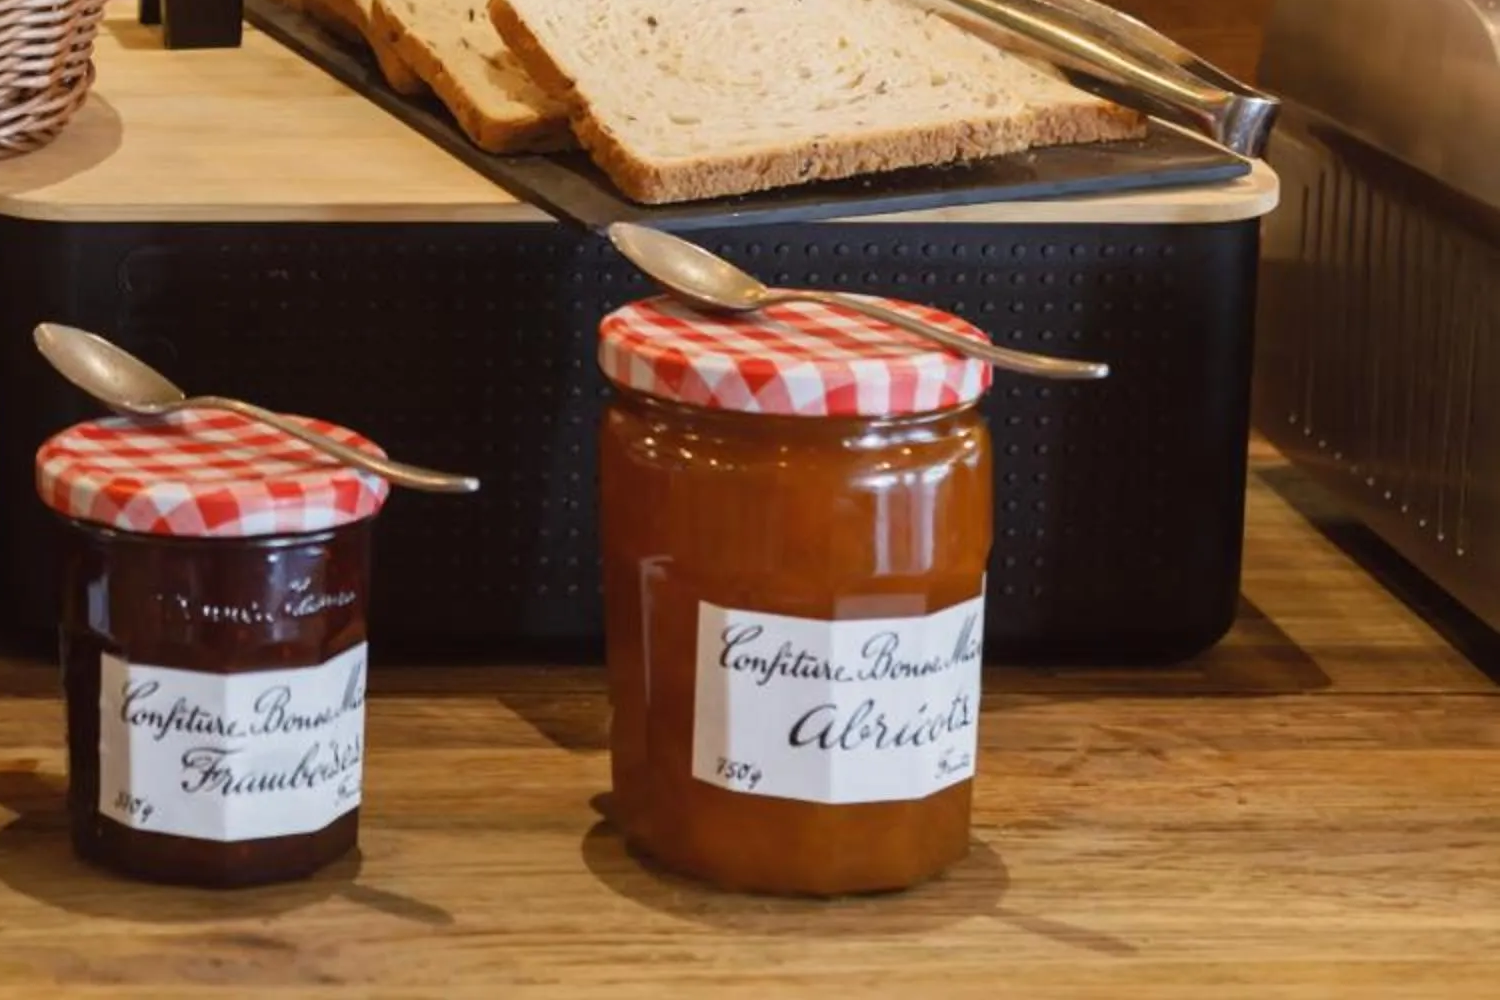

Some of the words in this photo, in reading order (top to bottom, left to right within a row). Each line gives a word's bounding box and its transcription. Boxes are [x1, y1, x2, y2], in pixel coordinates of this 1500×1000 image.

[718, 624, 853, 686] Confiture
[857, 631, 943, 682] Bonne
[120, 680, 246, 742] Confiture
[250, 685, 334, 737] Bonne
